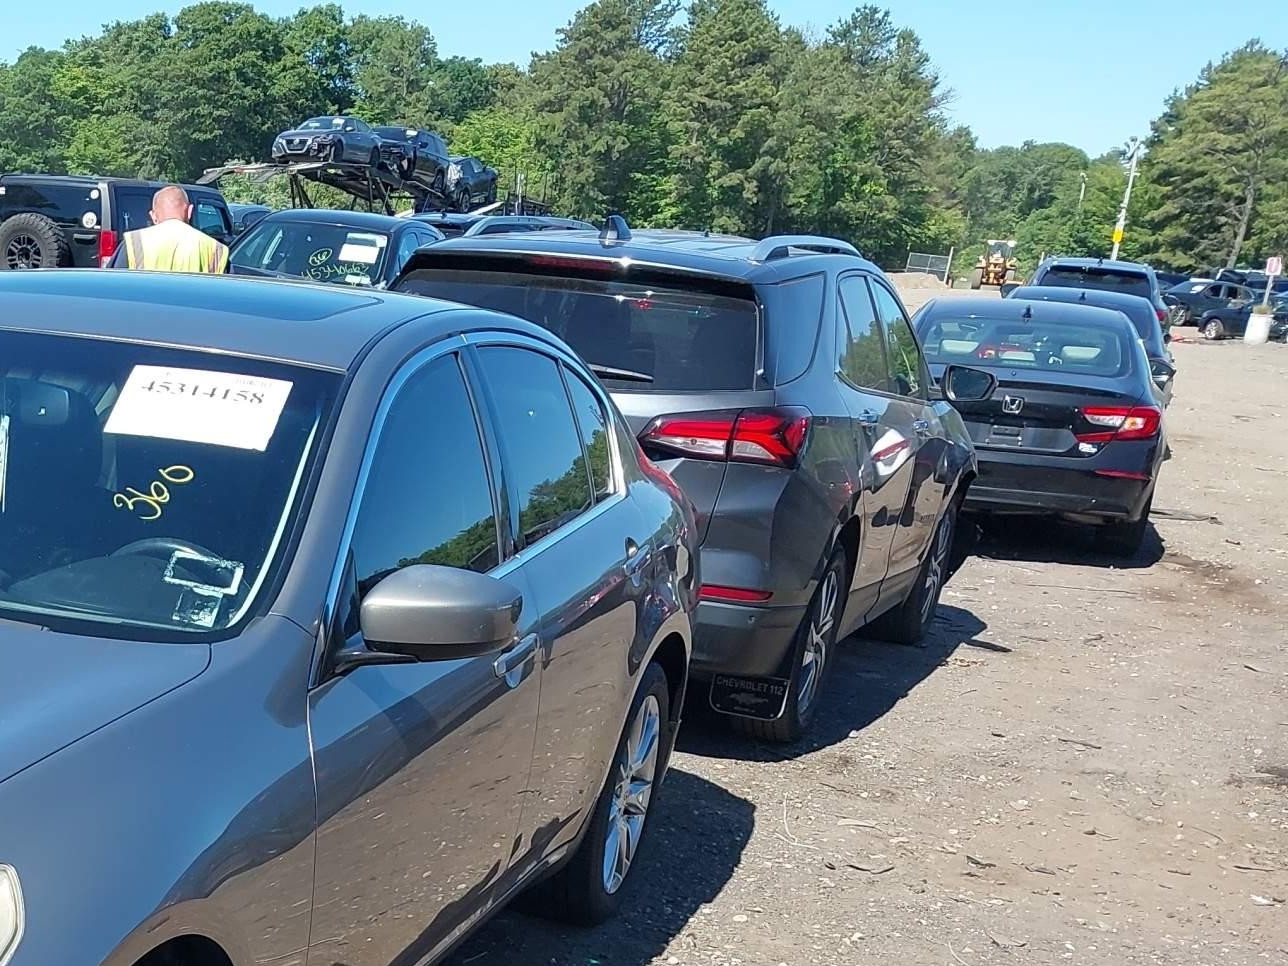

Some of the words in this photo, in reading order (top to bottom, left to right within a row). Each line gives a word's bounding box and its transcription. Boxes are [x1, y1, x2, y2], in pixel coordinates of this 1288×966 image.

[141, 380, 265, 405] 45314158
[113, 465, 196, 520] 360
[716, 676, 768, 692] CHEVROLET
[769, 685, 784, 696] 112
